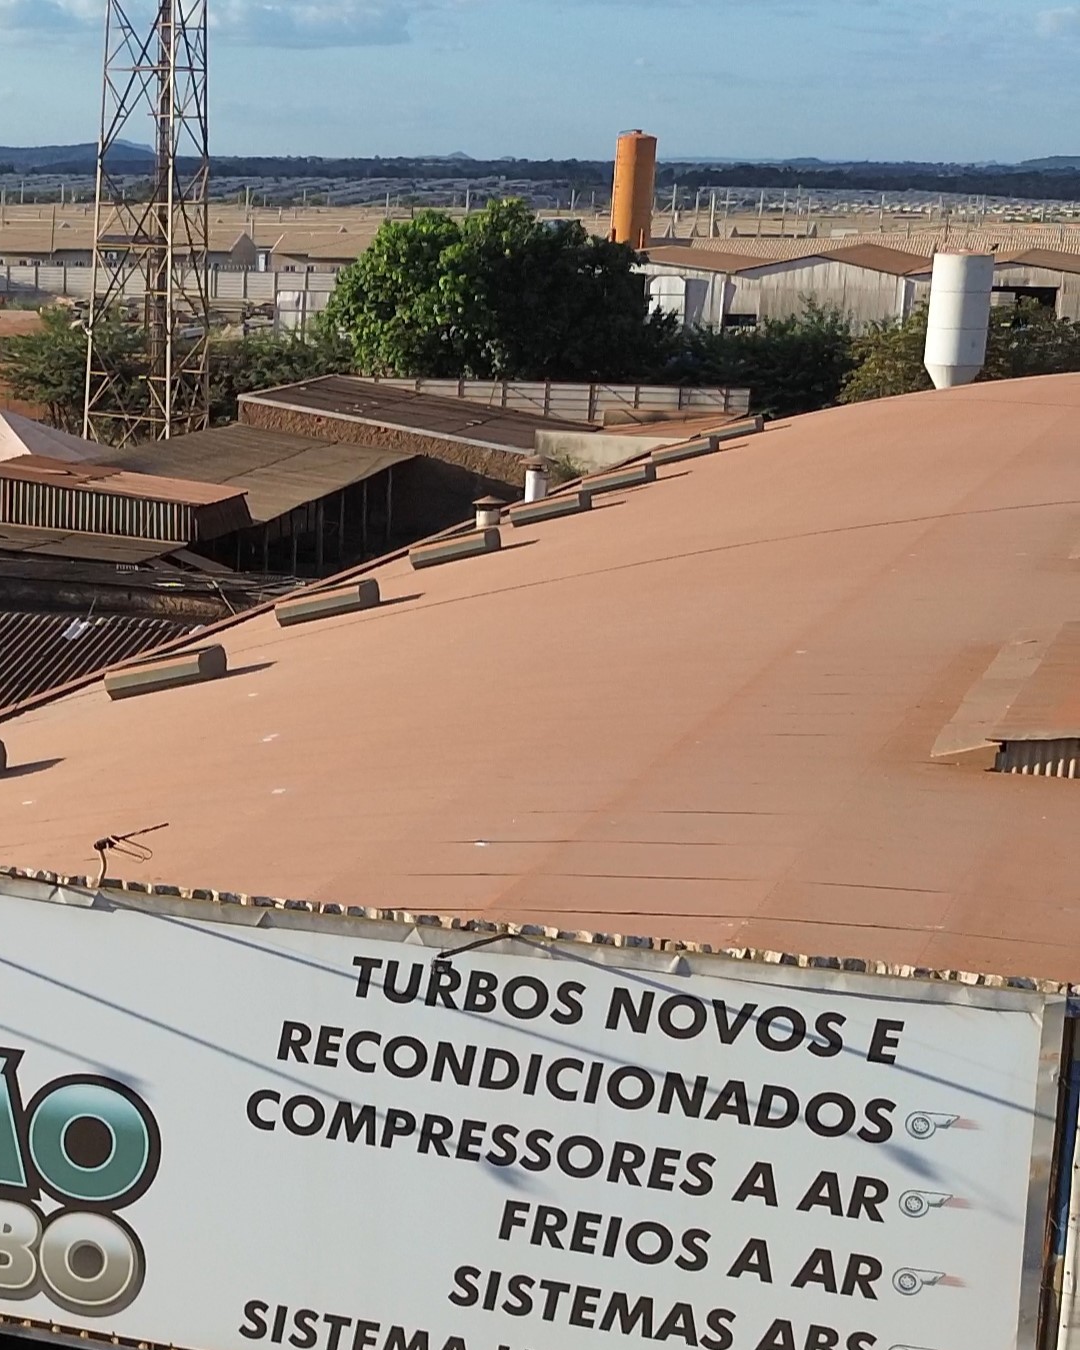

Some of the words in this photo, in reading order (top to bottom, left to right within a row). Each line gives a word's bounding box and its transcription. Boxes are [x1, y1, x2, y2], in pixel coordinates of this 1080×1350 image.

[352, 956, 587, 1025] TURBOS
[604, 987, 847, 1058] NOVOS
[866, 1018, 905, 1066] E
[276, 1020, 897, 1144] RECONDICIONADOS
[246, 1089, 717, 1196] COMPRESSORES
[731, 1161, 779, 1207] A
[795, 1170, 889, 1223] AR
[498, 1199, 712, 1272] FREIOS
[726, 1238, 773, 1284] A
[790, 1247, 883, 1301] AR
